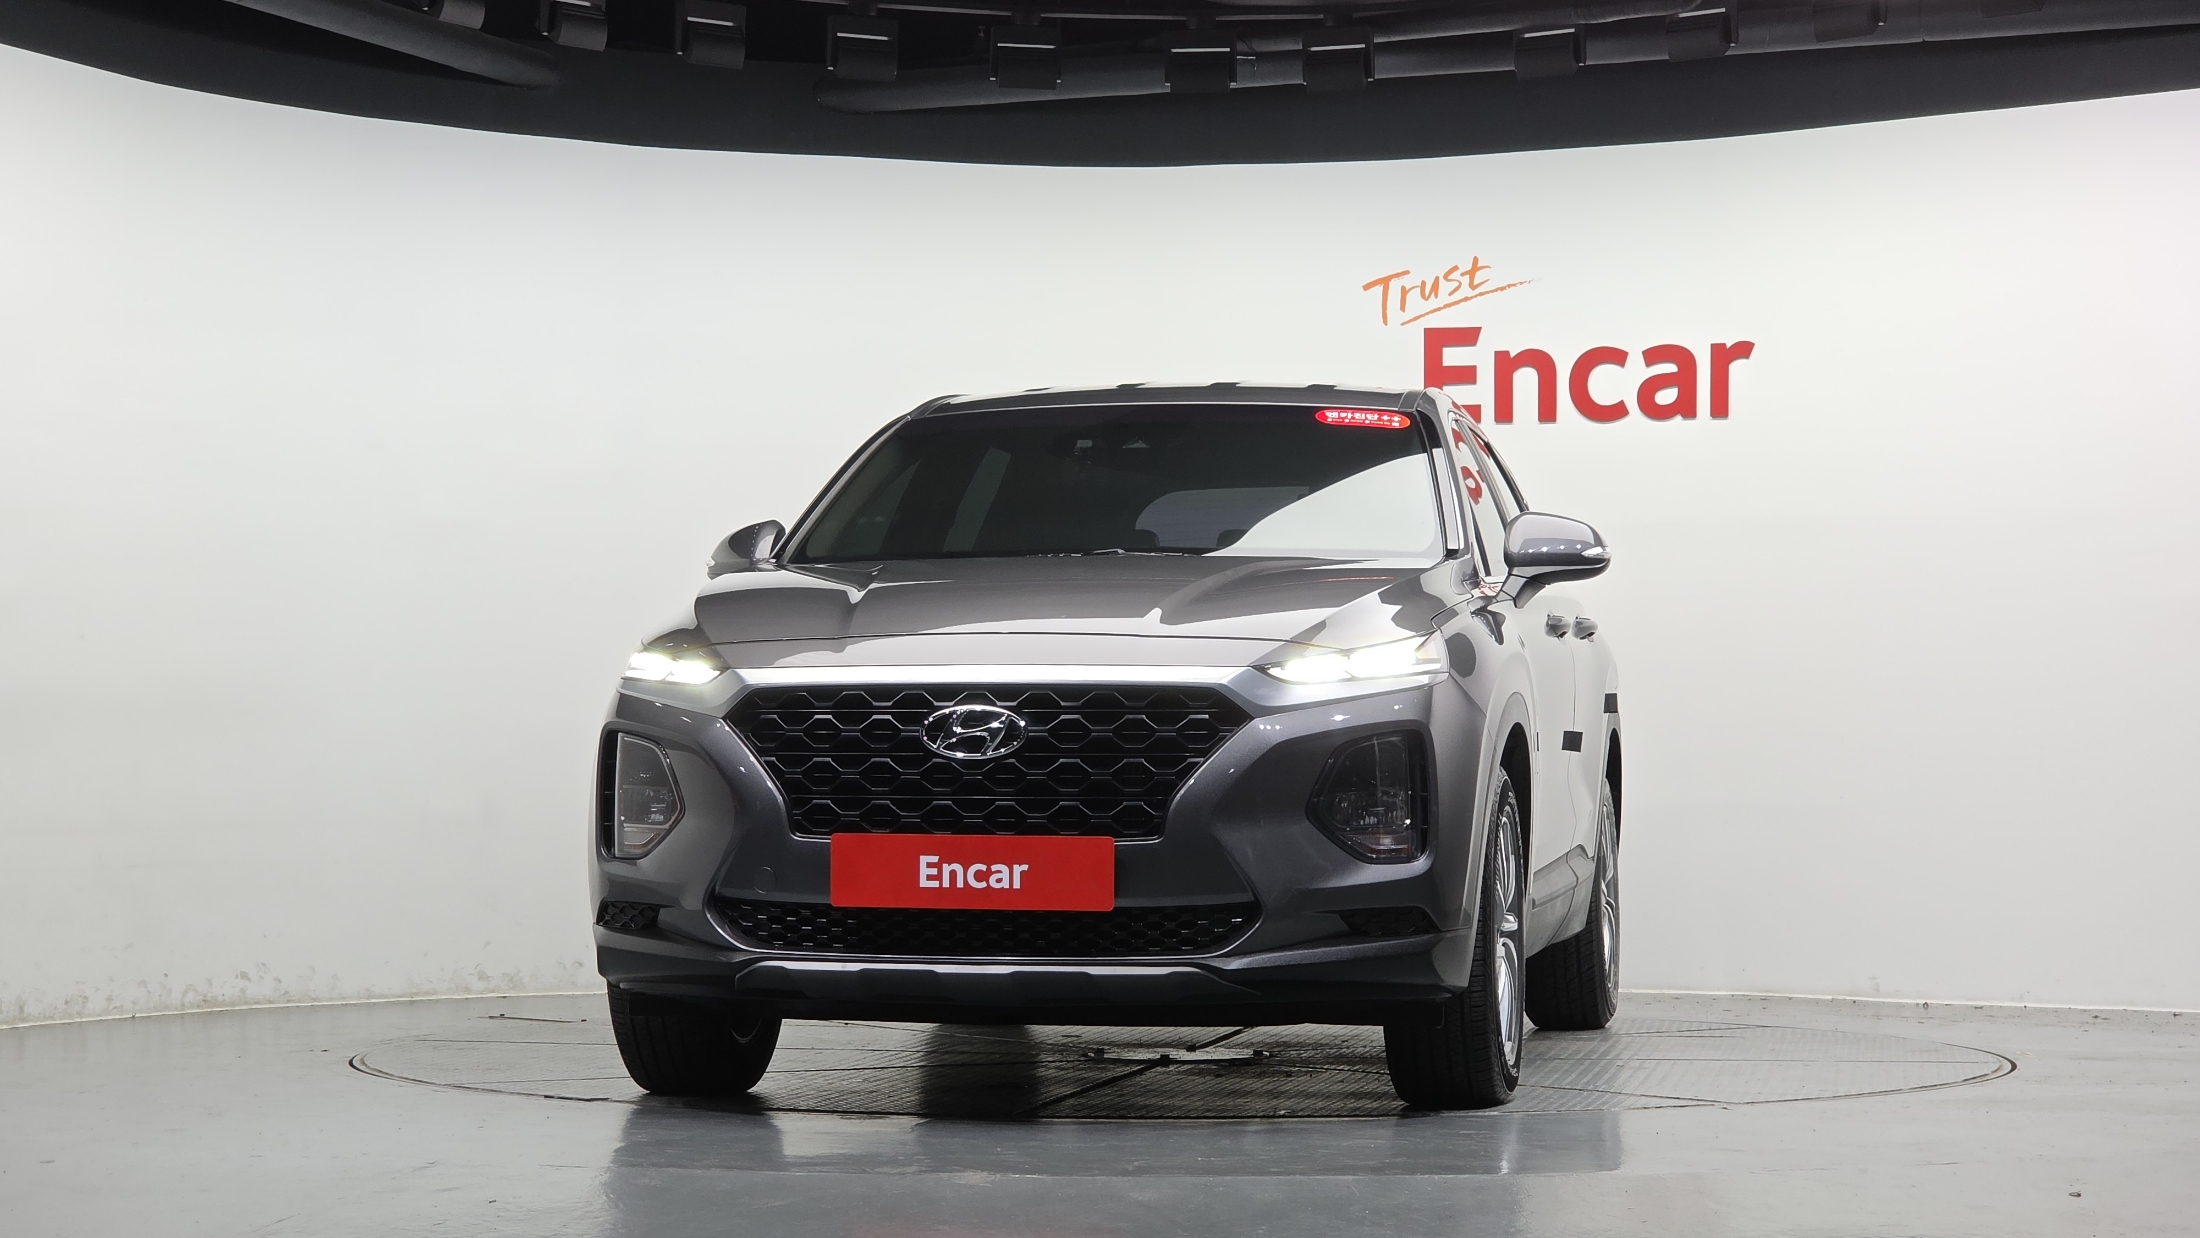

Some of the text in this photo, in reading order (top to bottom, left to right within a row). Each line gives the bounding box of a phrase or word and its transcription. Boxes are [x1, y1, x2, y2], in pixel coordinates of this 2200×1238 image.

[1362, 255, 1491, 326] Trust
[1423, 326, 1755, 424] Encar
[919, 855, 1029, 889] Encar
